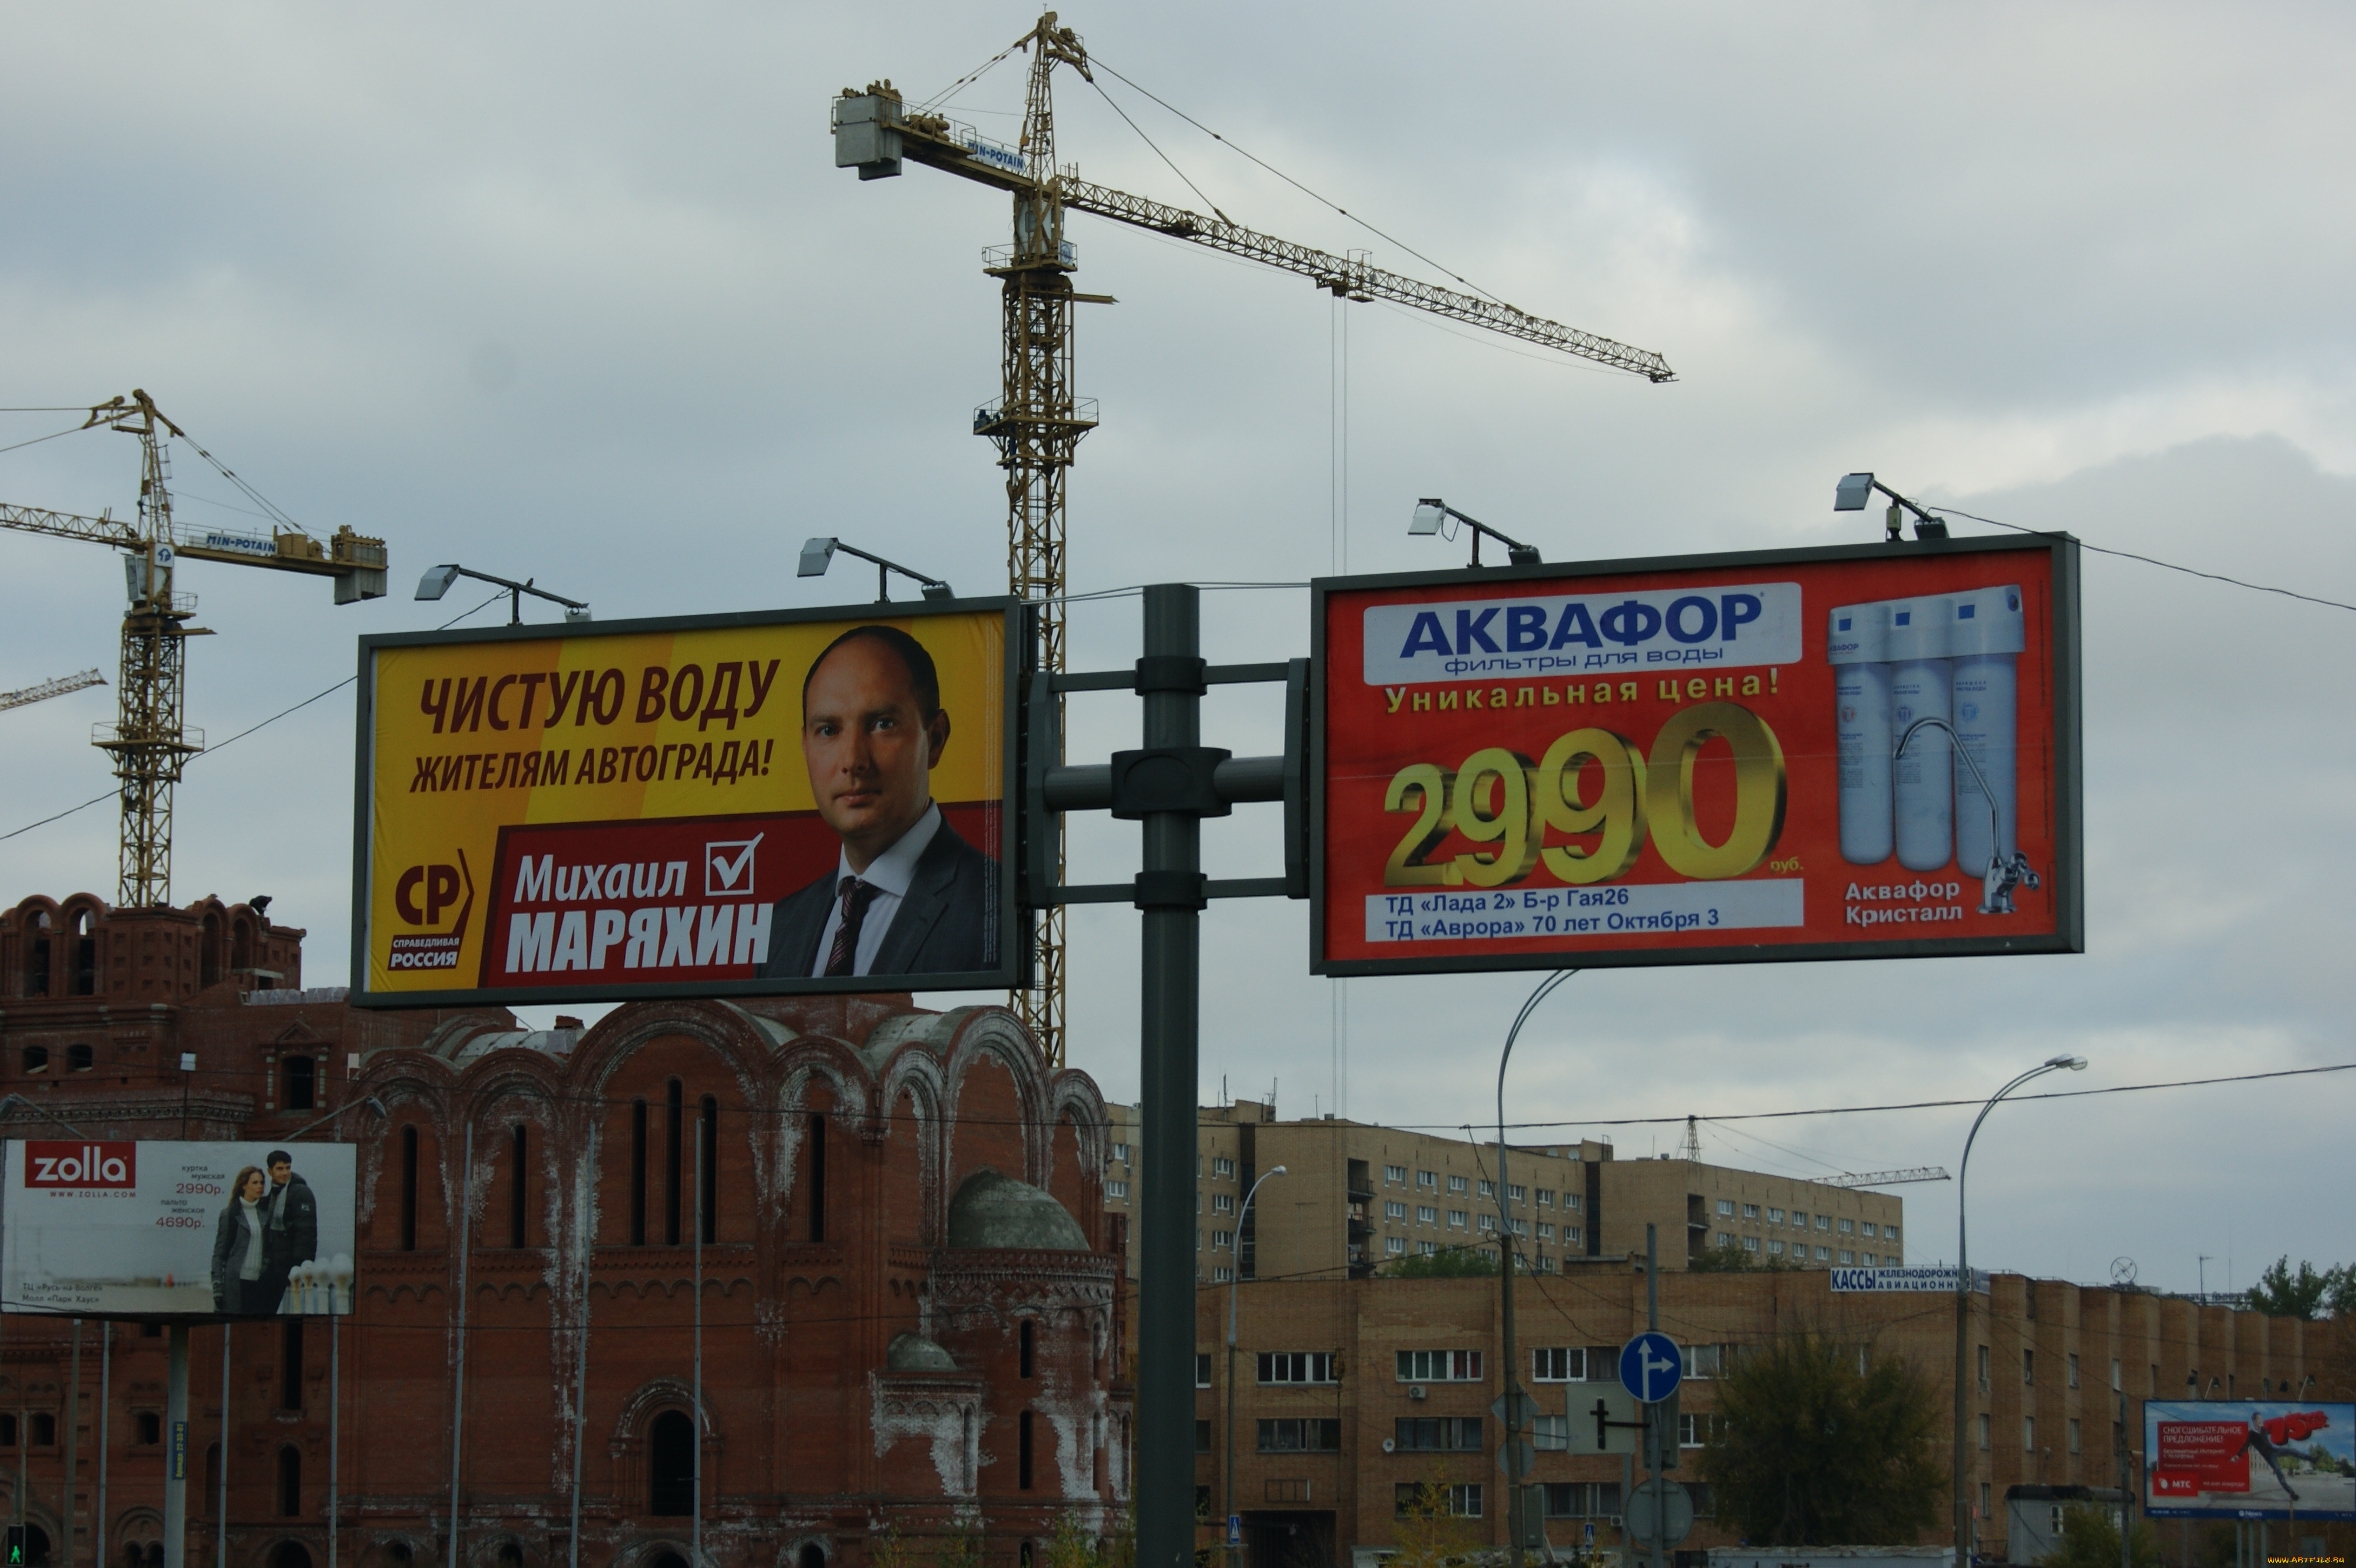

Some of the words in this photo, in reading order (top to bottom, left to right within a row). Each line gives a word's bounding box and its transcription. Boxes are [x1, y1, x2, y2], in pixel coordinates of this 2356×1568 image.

[207, 535, 276, 552] MIN-POTAIN
[1399, 594, 1762, 658] АКВАФОР
[1444, 654, 1577, 676] фильтры
[1584, 652, 1637, 668] для
[1647, 649, 1723, 664] воды
[420, 668, 626, 734] ЧИСТУЮ
[635, 659, 781, 732] ВОДУ
[1385, 682, 1637, 713] Уникальная
[1659, 667, 1779, 703] цена!
[409, 749, 570, 793] ЖИТЕЛЯМ
[574, 739, 774, 786] АВТОГРАДА!
[1384, 701, 1787, 887] 2990
[1770, 857, 1804, 875] руб.
[513, 854, 688, 903] Михаил
[395, 864, 461, 925] СР
[1386, 896, 1413, 914] ТД
[1421, 895, 1487, 912] «Лада
[1493, 892, 1515, 911] 2»
[1523, 891, 1560, 910] Б-р
[1567, 888, 1629, 907] Гая26
[1845, 879, 1960, 902] Аквафор
[1386, 921, 1413, 939] ТД
[1421, 918, 1525, 938] «Аврора»
[1533, 916, 1557, 932] 70
[1563, 917, 1600, 932] лет
[1607, 910, 1700, 931] Октября
[1708, 909, 1719, 925] 3
[1846, 905, 1963, 927] Кристалл
[393, 937, 460, 948] СПРАВЕДЛИВАЯ
[505, 902, 774, 973] МАРЯХИН
[391, 951, 458, 967] РОССИЯ
[35, 1146, 126, 1182] zolla
[176, 1183, 224, 1196] 2990р.
[155, 1216, 204, 1229] 4690р.
[1832, 1270, 1875, 1289] КАССЫ
[1878, 1269, 1970, 1278] ЖЕЛЕЗНОДОРОЖНЕ
[24, 1282, 34, 1291] ТЦ
[1878, 1281, 1970, 1290] АВИАЦИОННЕ
[2163, 1426, 2242, 1434] СНОГСШИБАТЕЛЬНОЕ
[2163, 1435, 2223, 1443] ПРЕДЛОЖЕНИЕ!
